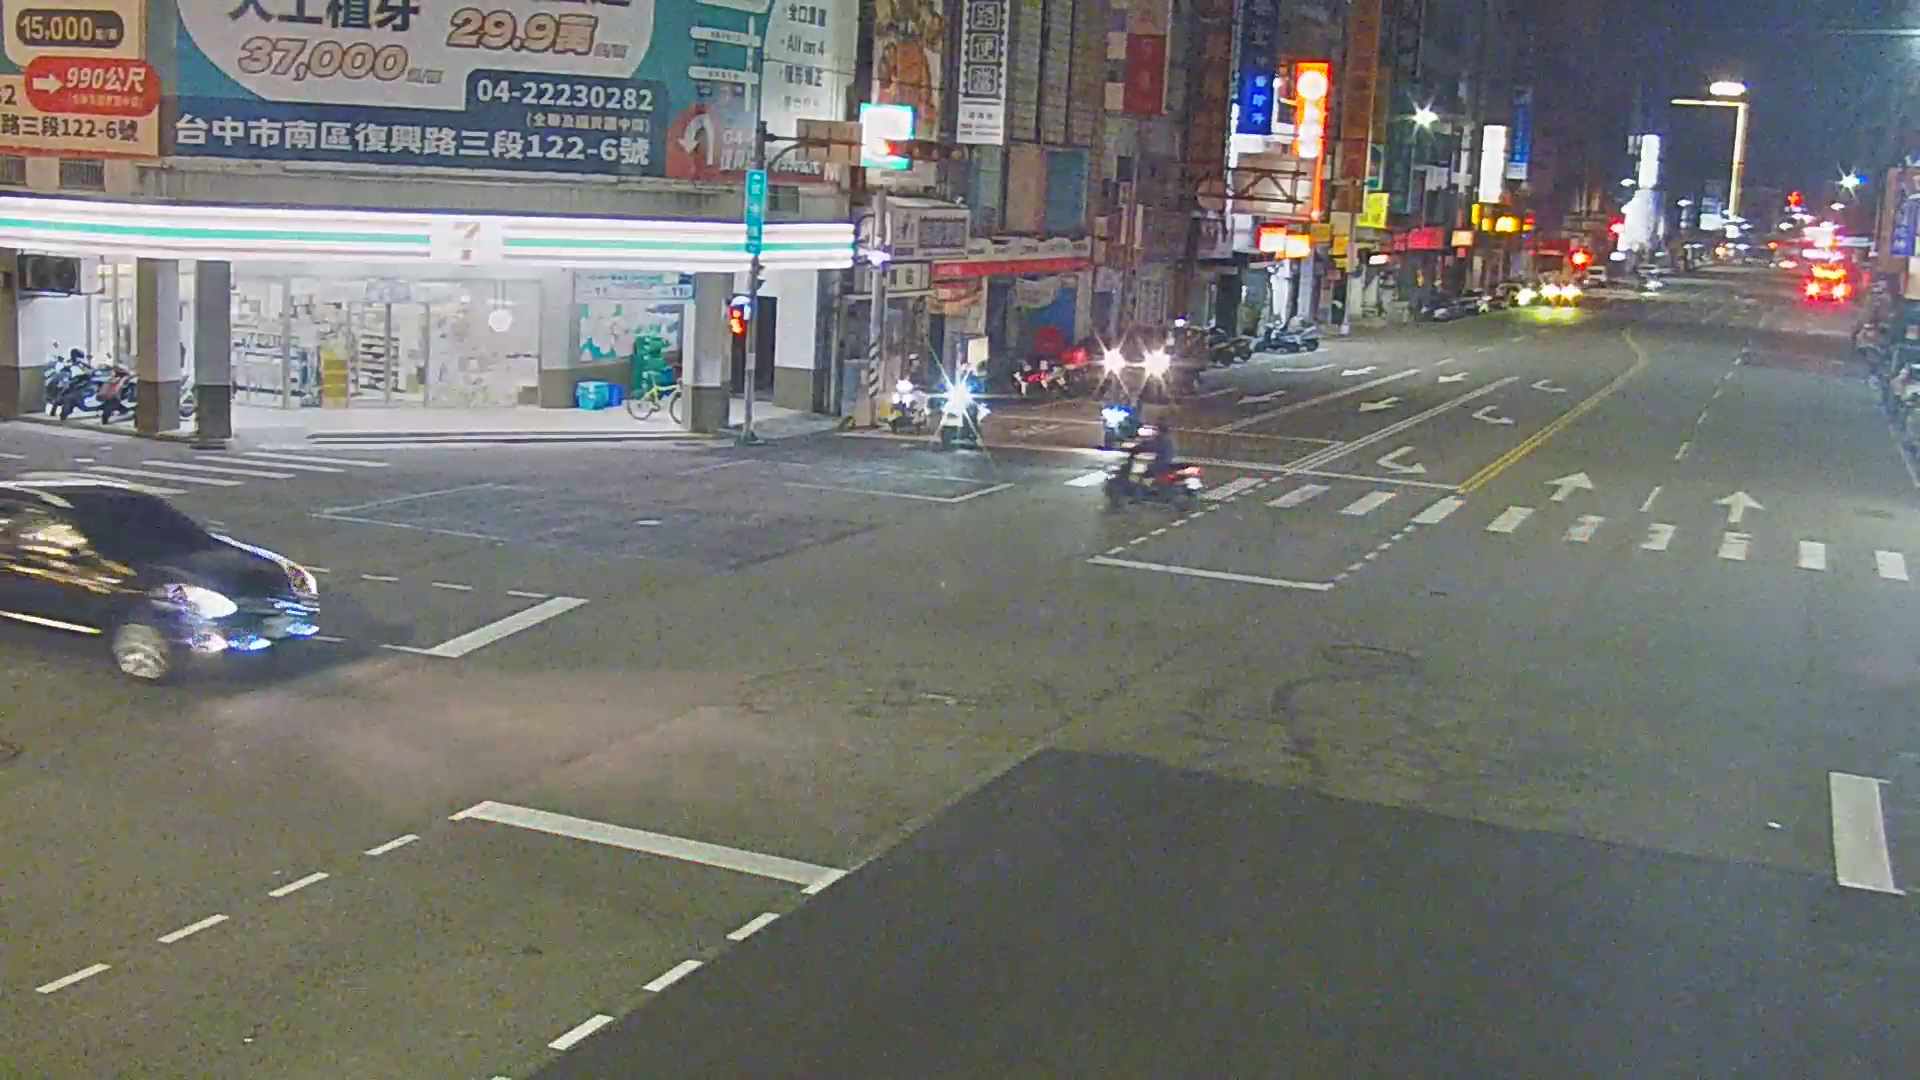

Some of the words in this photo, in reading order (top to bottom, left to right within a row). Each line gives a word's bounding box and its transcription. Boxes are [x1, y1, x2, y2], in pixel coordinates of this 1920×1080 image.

[238, 36, 409, 81] 37,000
[65, 67, 146, 93] 990公尺
[477, 78, 654, 112] 04-22230282
[176, 113, 650, 166] 台中市南區復興路三段122-6號
